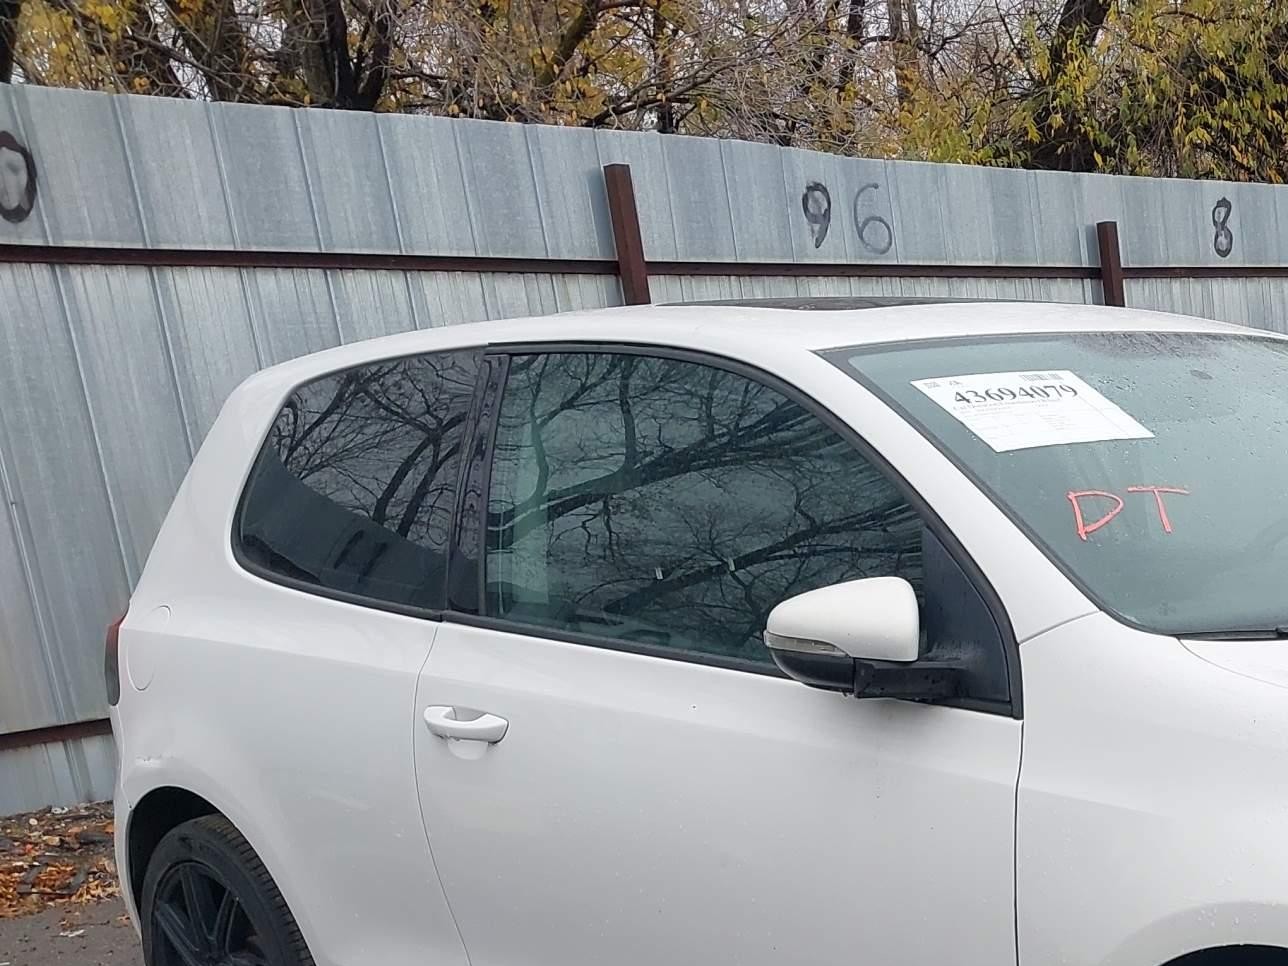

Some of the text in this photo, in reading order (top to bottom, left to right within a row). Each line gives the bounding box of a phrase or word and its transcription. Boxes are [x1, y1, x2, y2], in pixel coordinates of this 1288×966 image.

[1212, 197, 1233, 258] 8
[954, 384, 1079, 404] 43694079
[1066, 485, 1190, 541] DT
